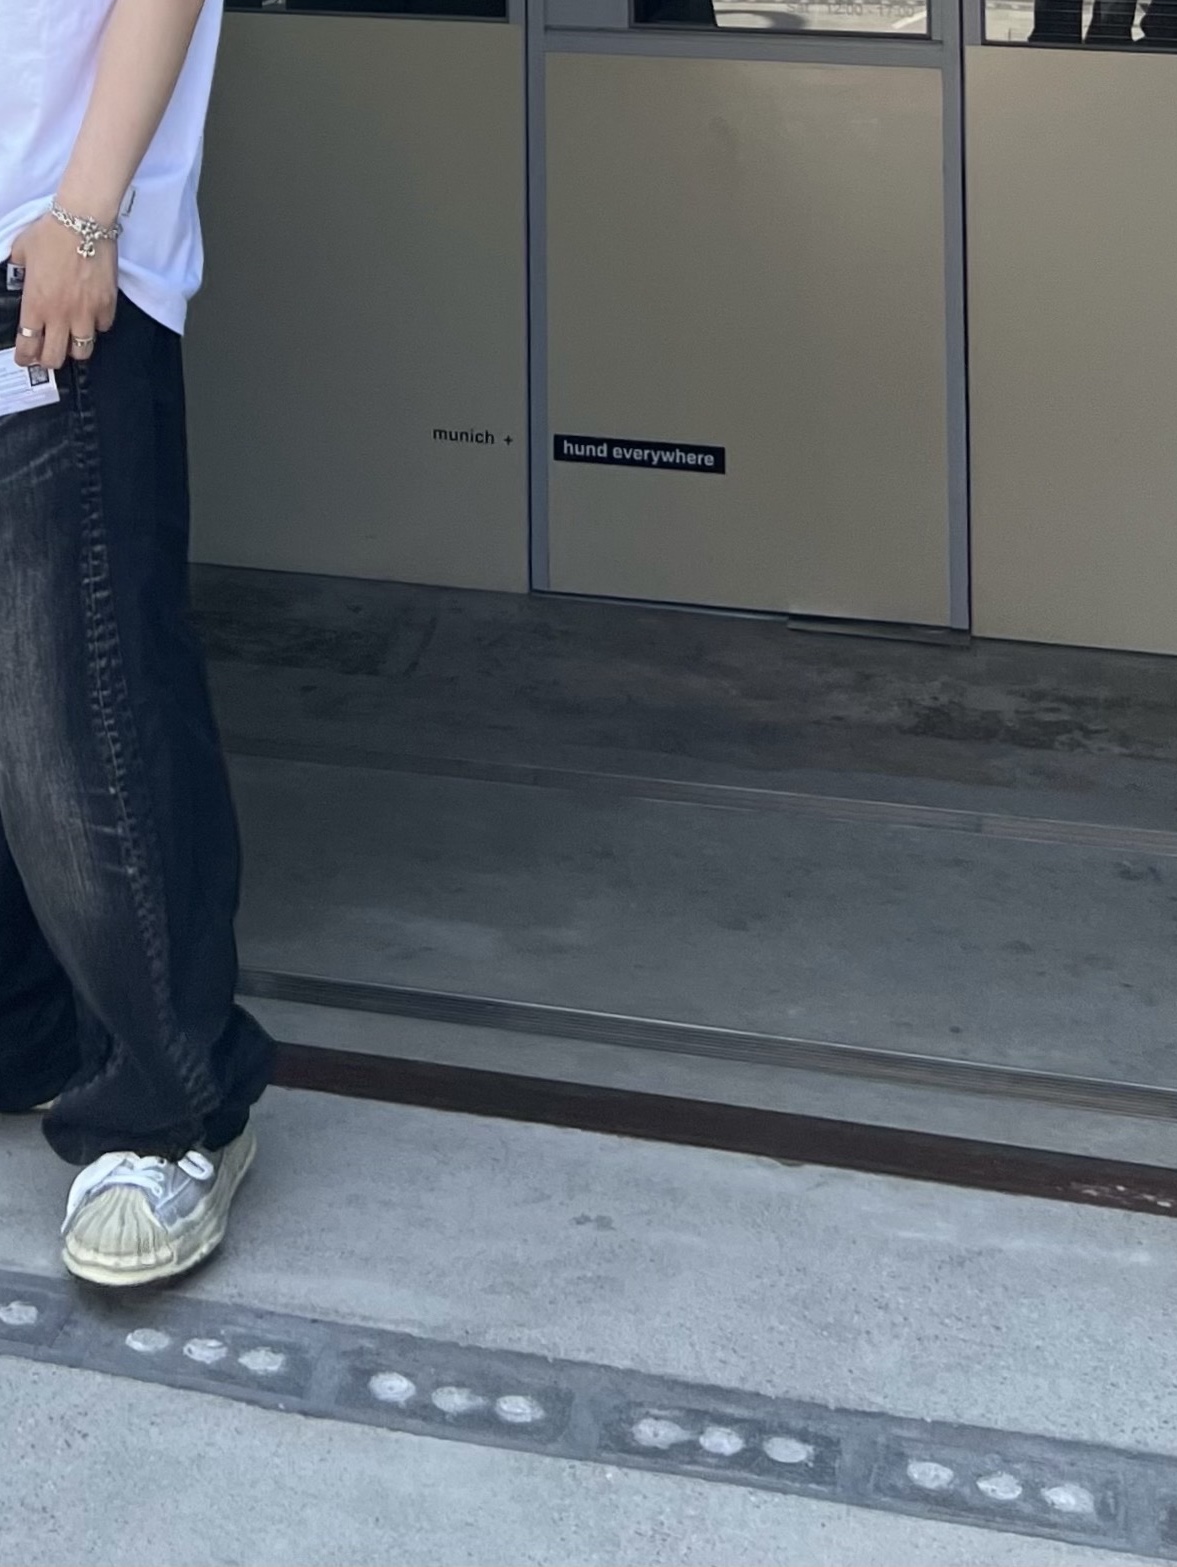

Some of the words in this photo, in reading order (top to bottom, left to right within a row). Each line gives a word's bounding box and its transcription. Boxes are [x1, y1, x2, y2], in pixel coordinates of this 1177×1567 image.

[432, 427, 495, 445] munich
[562, 439, 608, 458] hund
[612, 445, 715, 467] everywhere
